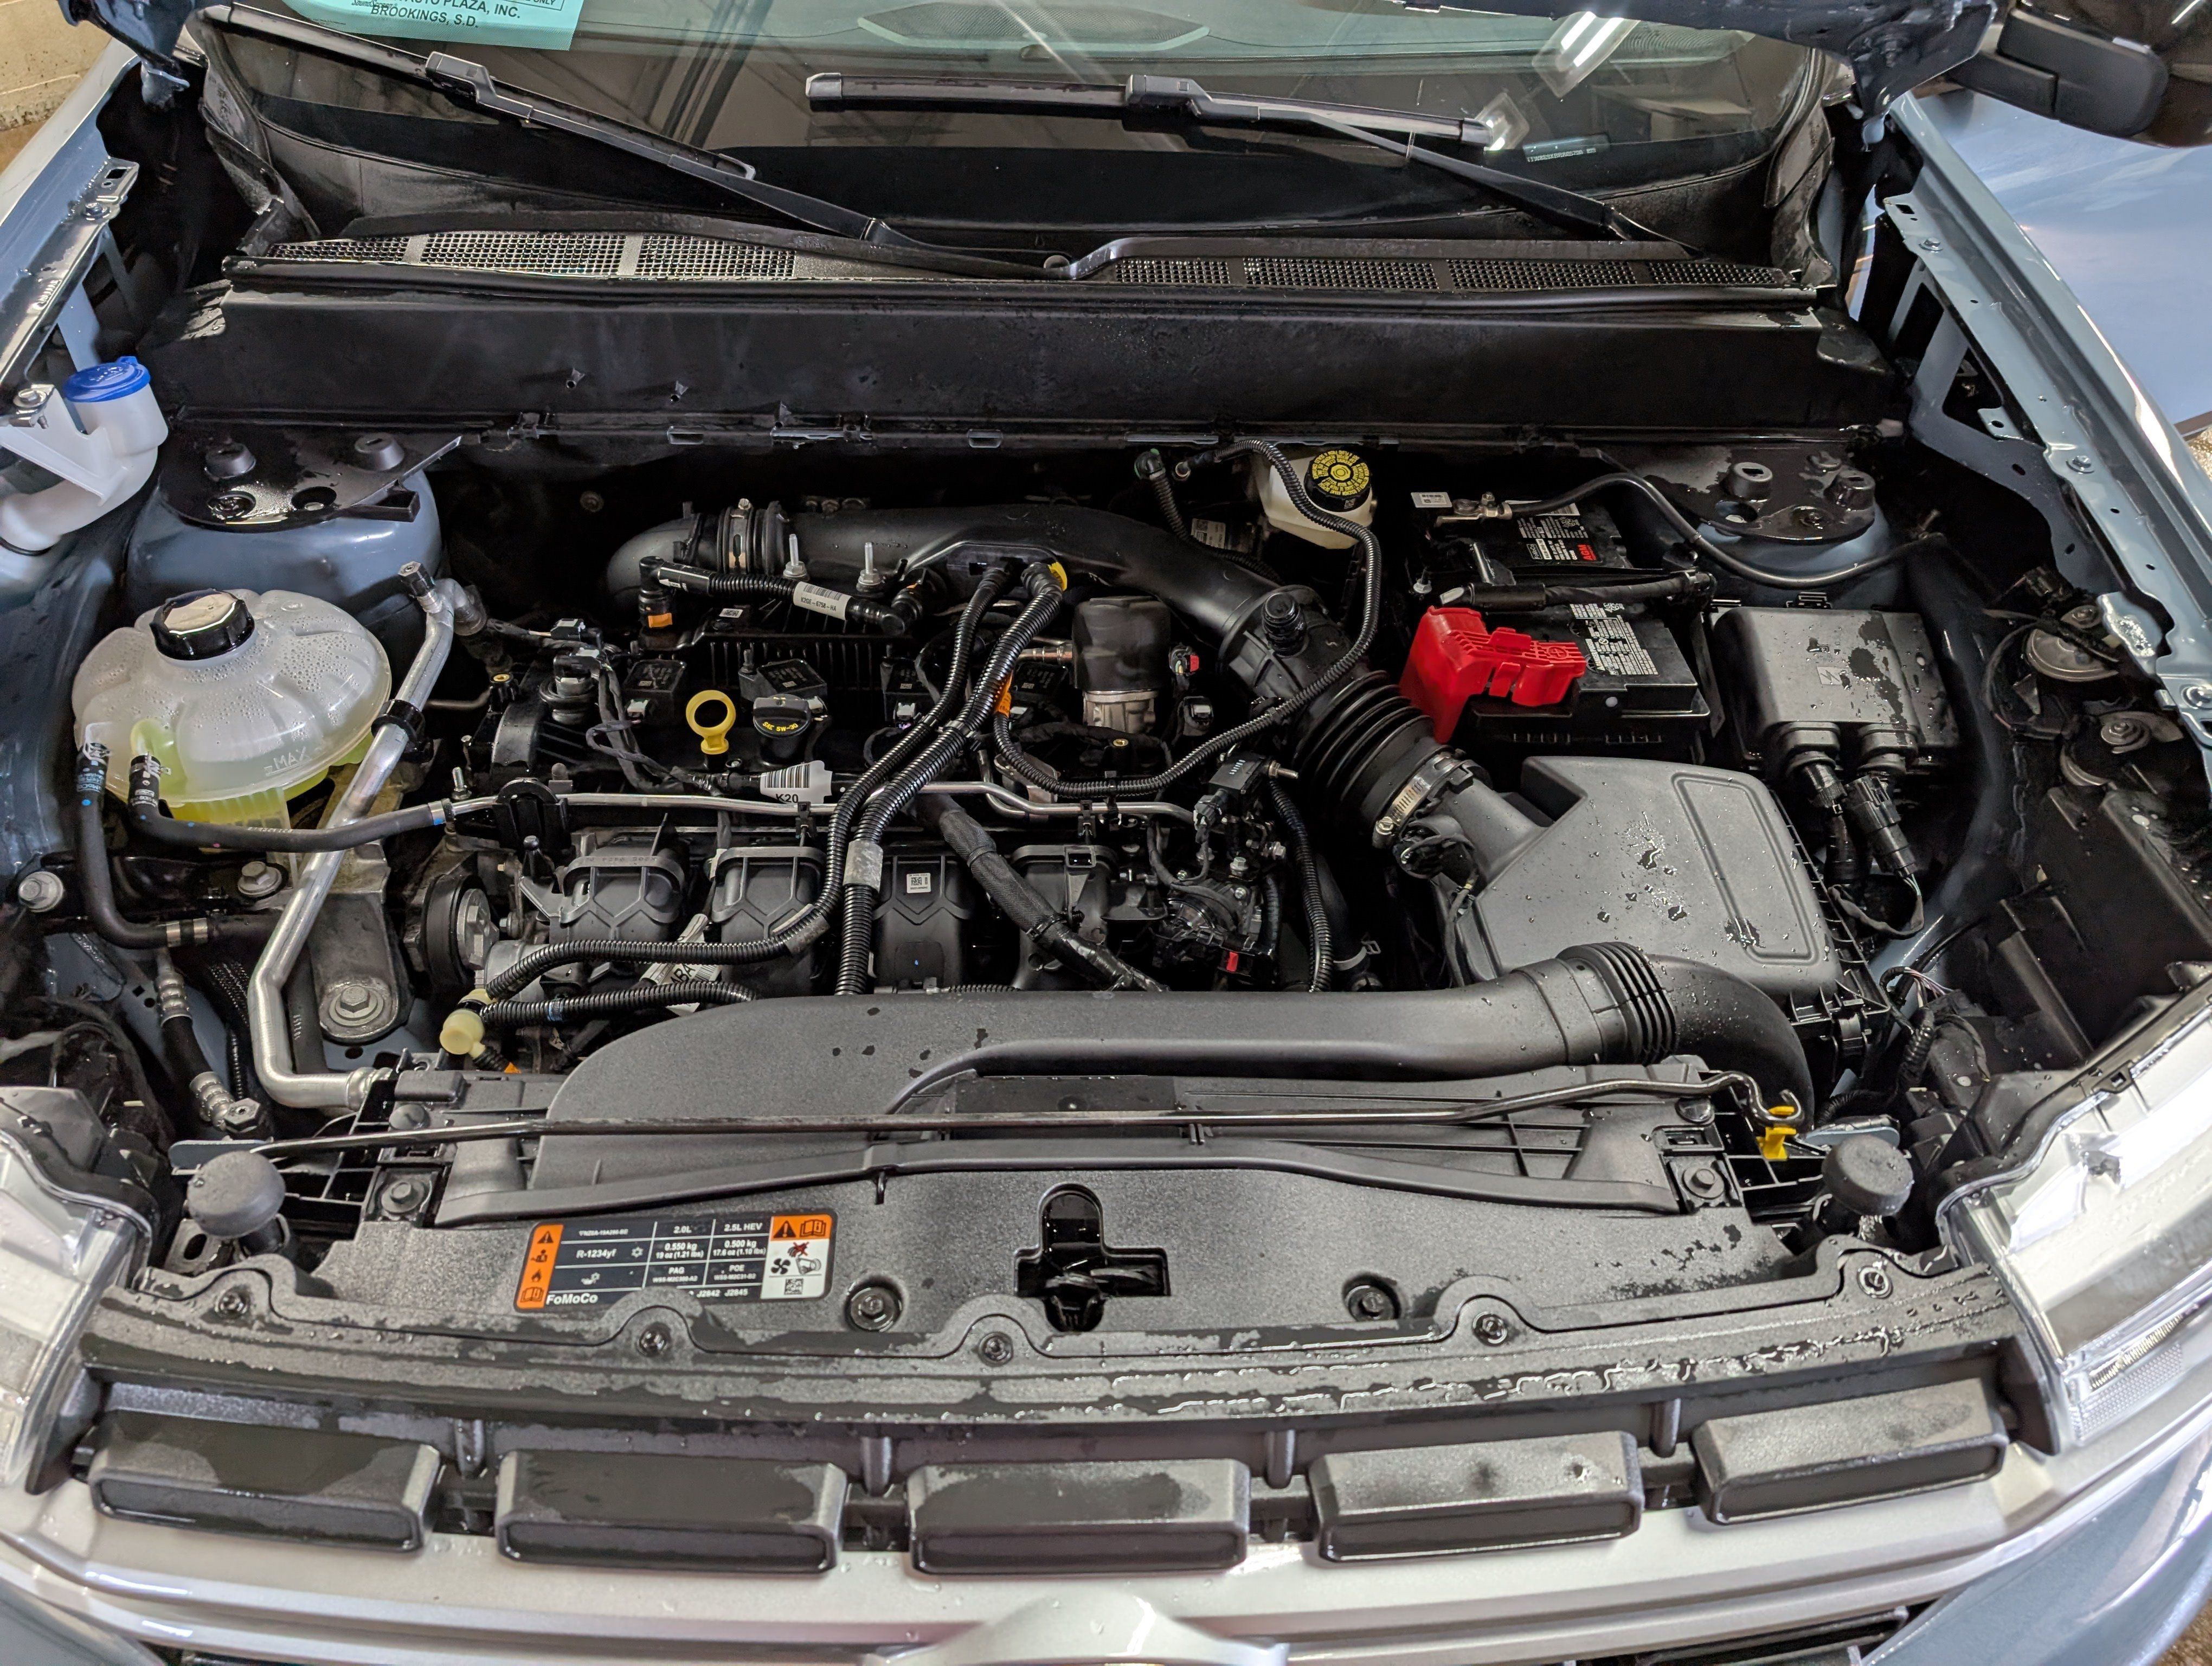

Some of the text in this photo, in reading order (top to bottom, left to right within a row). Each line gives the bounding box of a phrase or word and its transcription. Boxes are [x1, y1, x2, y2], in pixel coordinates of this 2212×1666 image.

[494, 4, 520, 18] INC.
[371, 5, 478, 28] BROOKINGS, S.D.
[1577, 544, 1594, 560] AGM
[762, 722, 799, 732] SAE 5W-30
[673, 1226, 692, 1234] 2.0L
[724, 1222, 763, 1232] 2.5L HEV
[665, 1242, 698, 1252] 0.550 kg
[724, 1240, 757, 1248] 0.500 kg
[576, 1248, 618, 1259] R-1234yf
[668, 1266, 685, 1274] PAG
[729, 1264, 745, 1272] POE
[546, 1293, 599, 1305] FoMoCo
